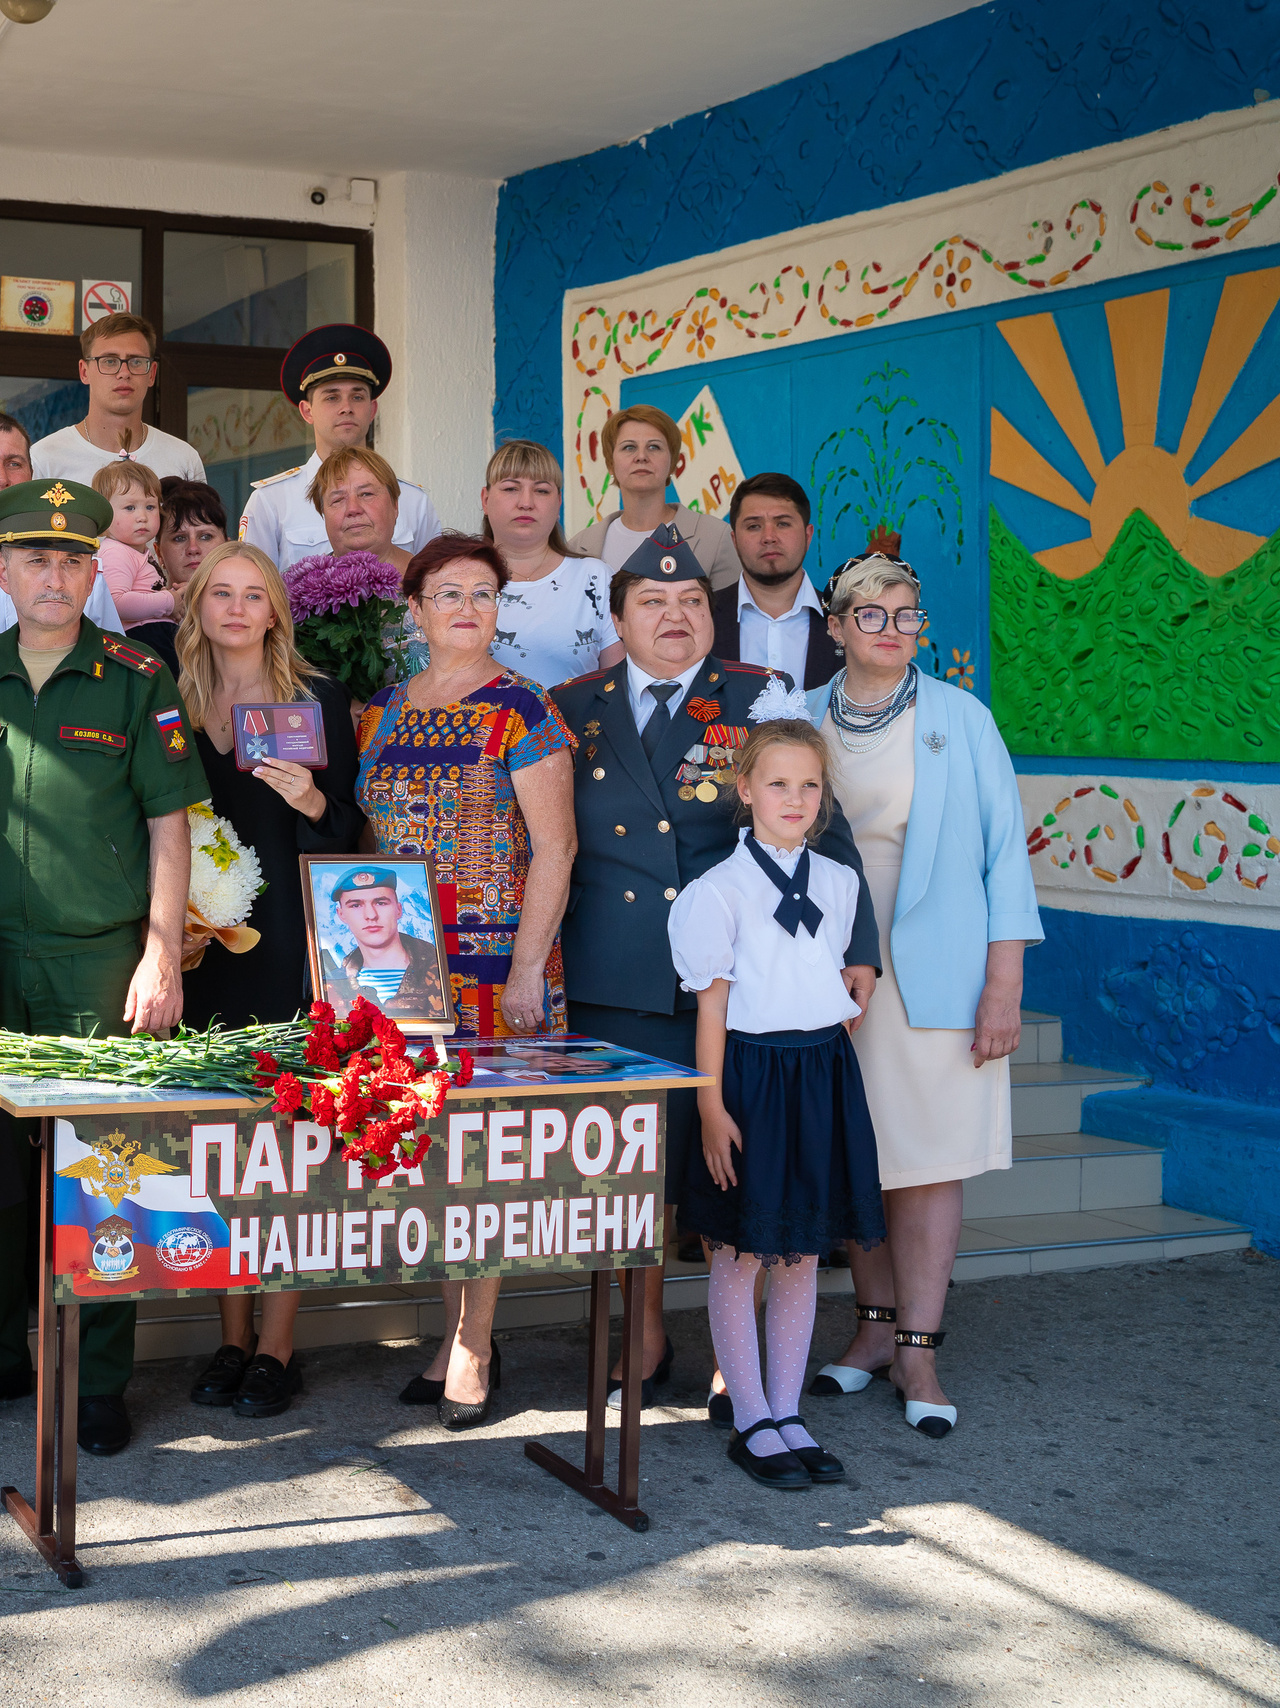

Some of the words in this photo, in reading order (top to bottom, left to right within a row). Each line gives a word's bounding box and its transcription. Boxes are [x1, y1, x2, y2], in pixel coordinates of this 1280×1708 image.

[74, 730, 100, 739] КОЗЛОВ
[102, 733, 114, 743] С.В.
[447, 1103, 659, 1184] ГЕРОЯ
[230, 1206, 429, 1276] НАШЕГО
[444, 1193, 656, 1264] ВРЕМЕНИ
